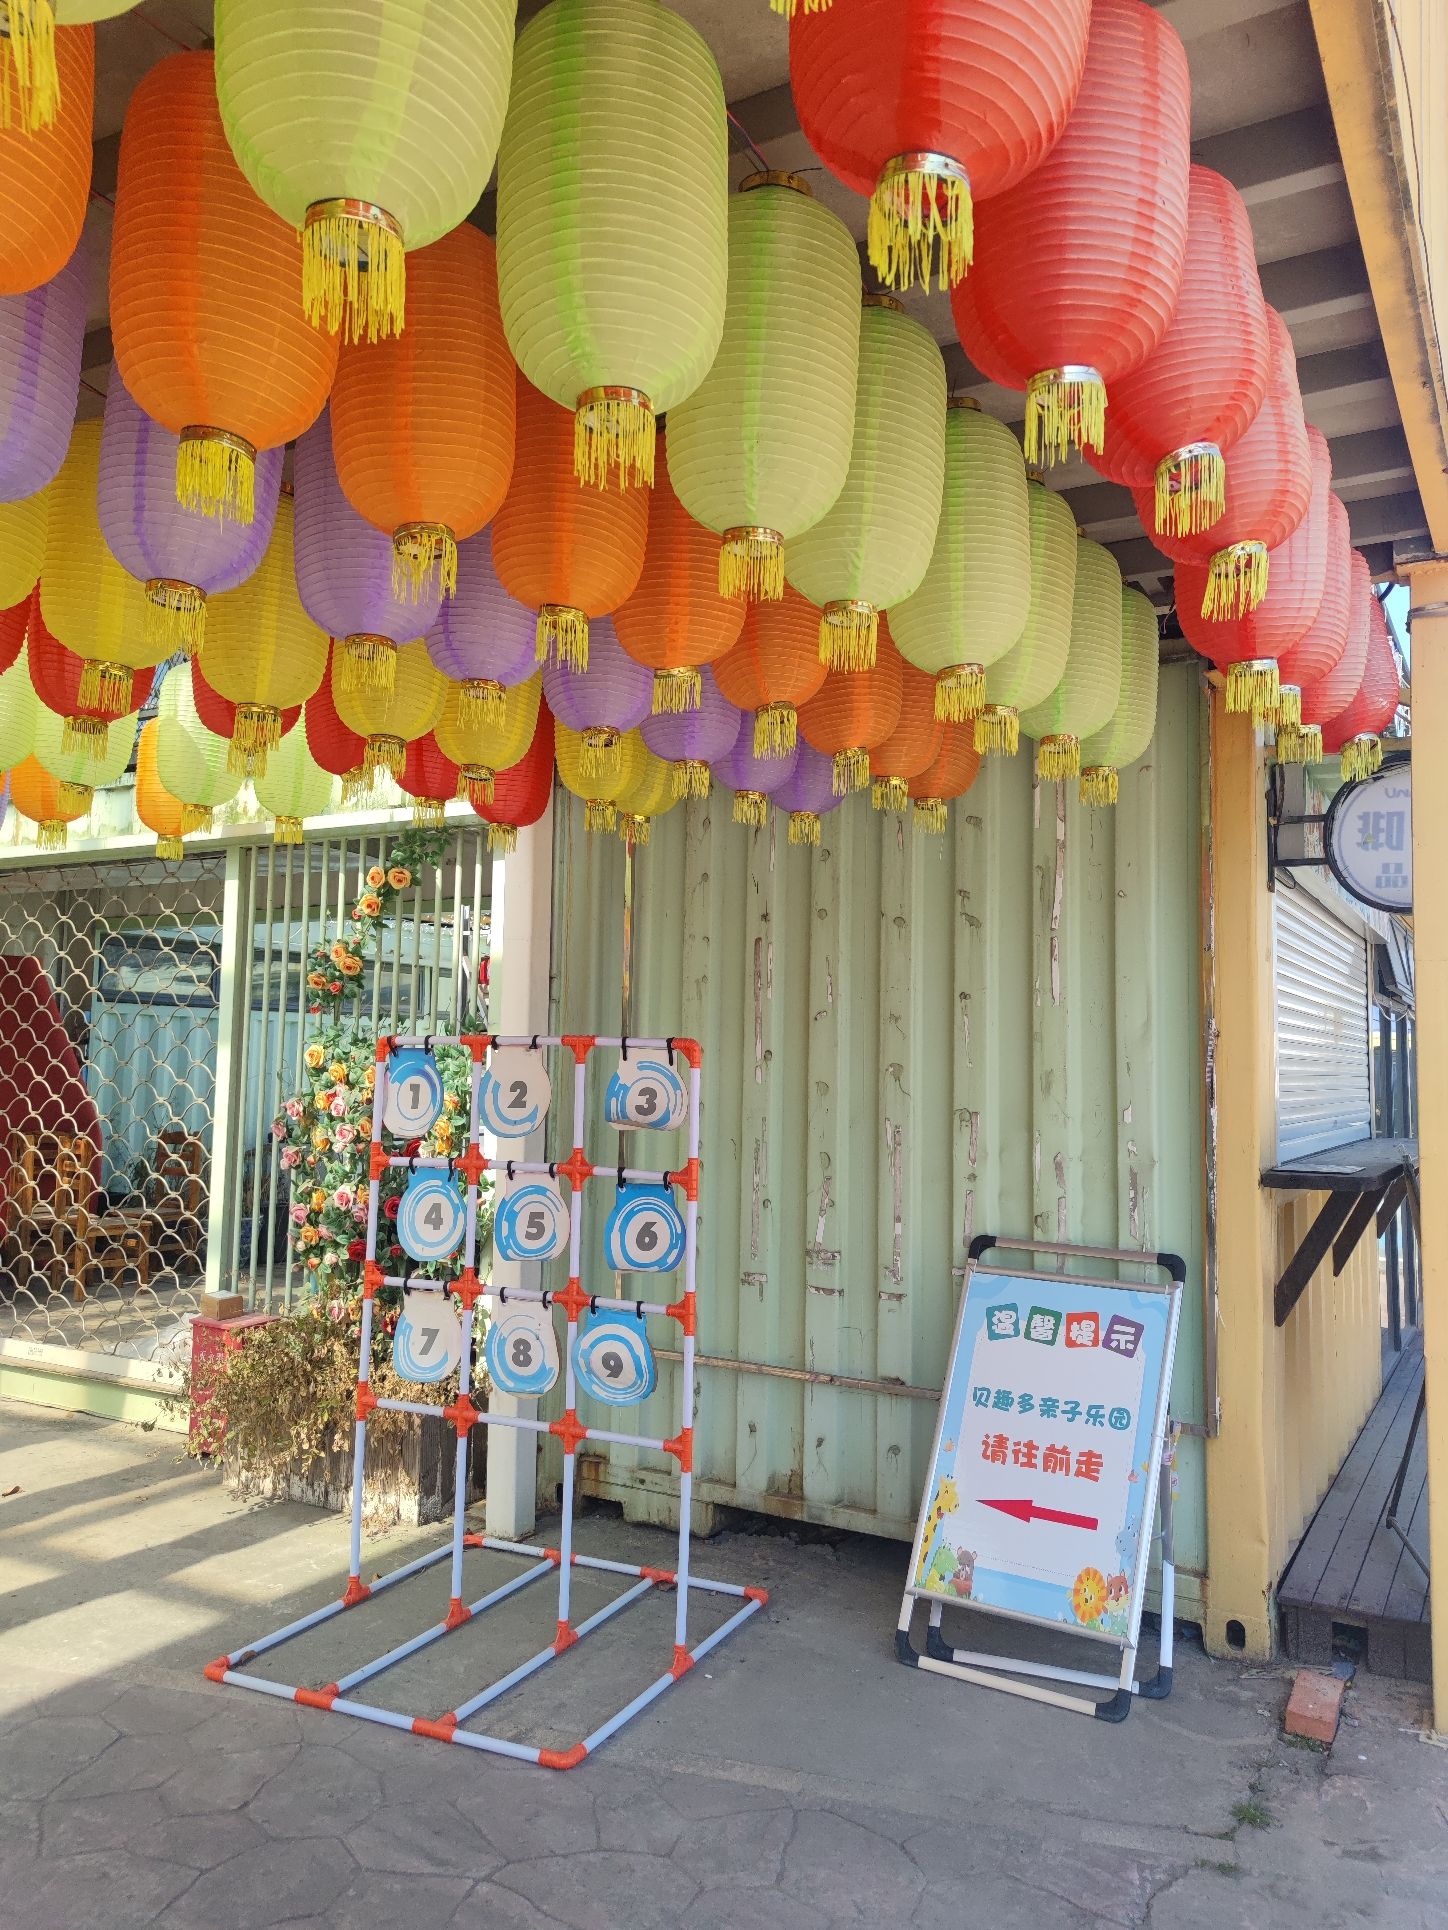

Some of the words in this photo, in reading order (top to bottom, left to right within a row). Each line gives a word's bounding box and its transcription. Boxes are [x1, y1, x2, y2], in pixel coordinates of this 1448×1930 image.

[408, 1083, 421, 1110] 1
[507, 1080, 528, 1109] 2
[634, 1087, 658, 1116] 3
[423, 1202, 444, 1231] 4
[525, 1211, 546, 1241] 5
[635, 1221, 659, 1252] 6
[419, 1328, 440, 1356] 7
[990, 1309, 1137, 1351] 温馨提示
[511, 1337, 532, 1368] 8
[601, 1351, 624, 1379] 9
[972, 1386, 1132, 1431] 贝趣多亲子乐园
[981, 1433, 1104, 1483] 请往前走
